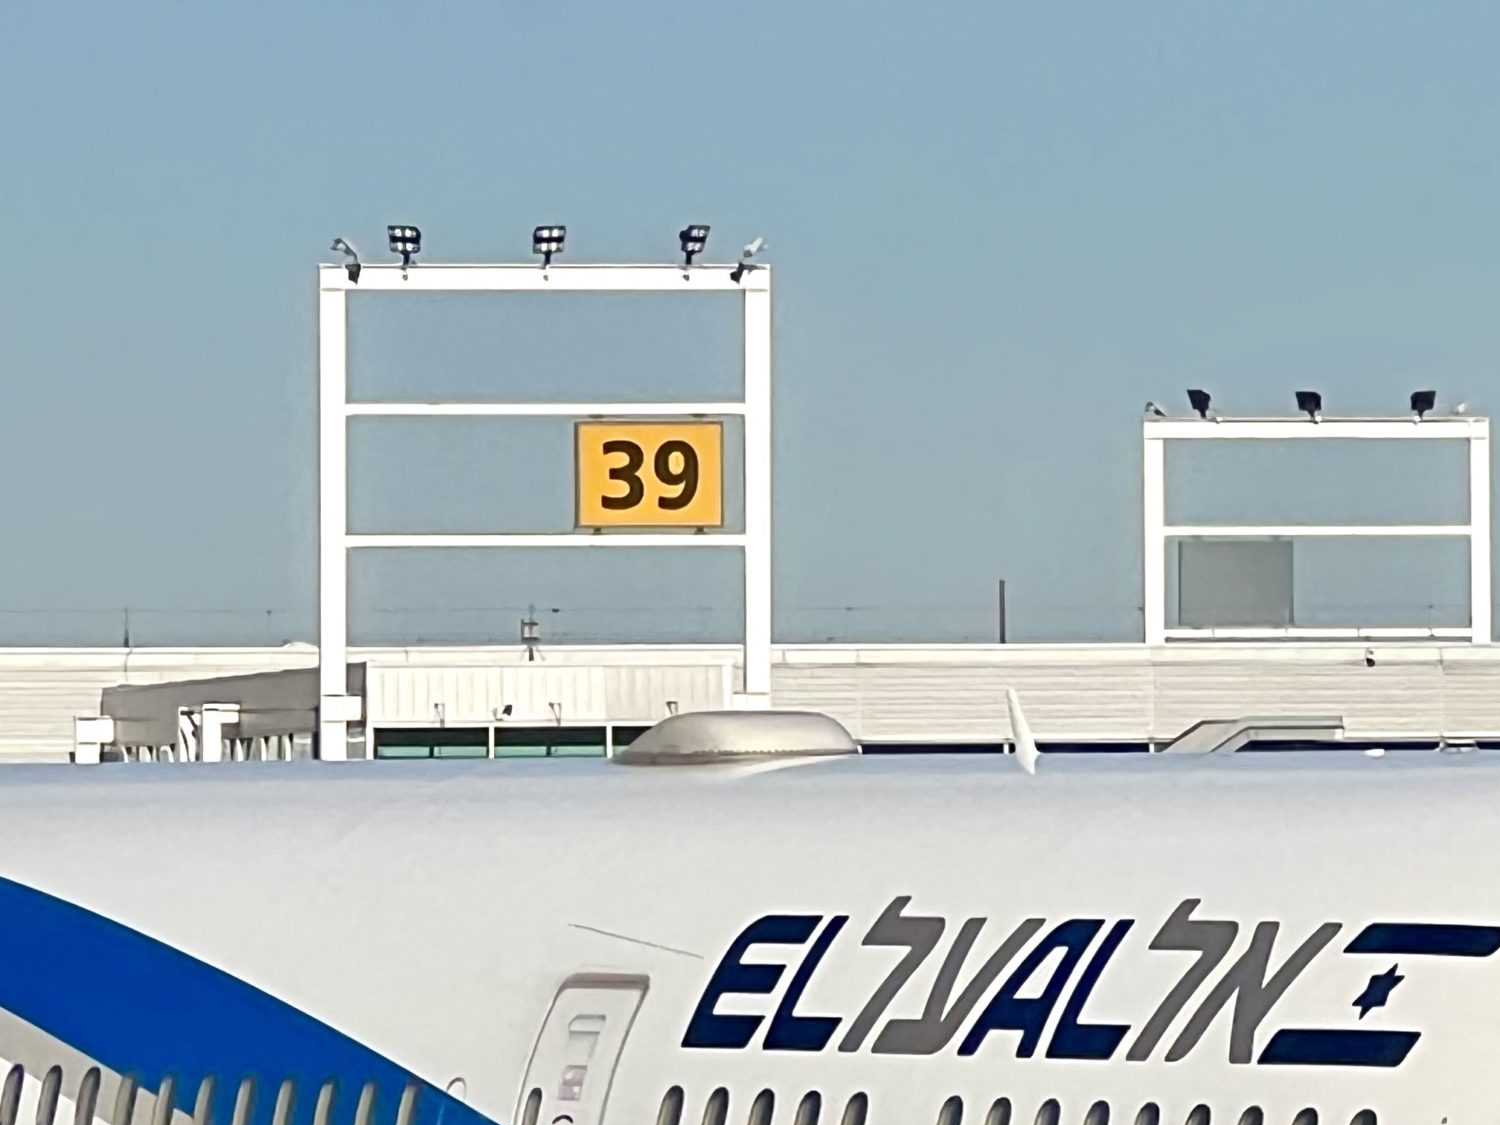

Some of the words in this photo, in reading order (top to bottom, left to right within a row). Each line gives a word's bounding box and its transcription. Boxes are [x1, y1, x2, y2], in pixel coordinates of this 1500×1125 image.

[601, 440, 699, 510] 39
[681, 914, 850, 1052] EL
[957, 918, 1136, 1061] AL
